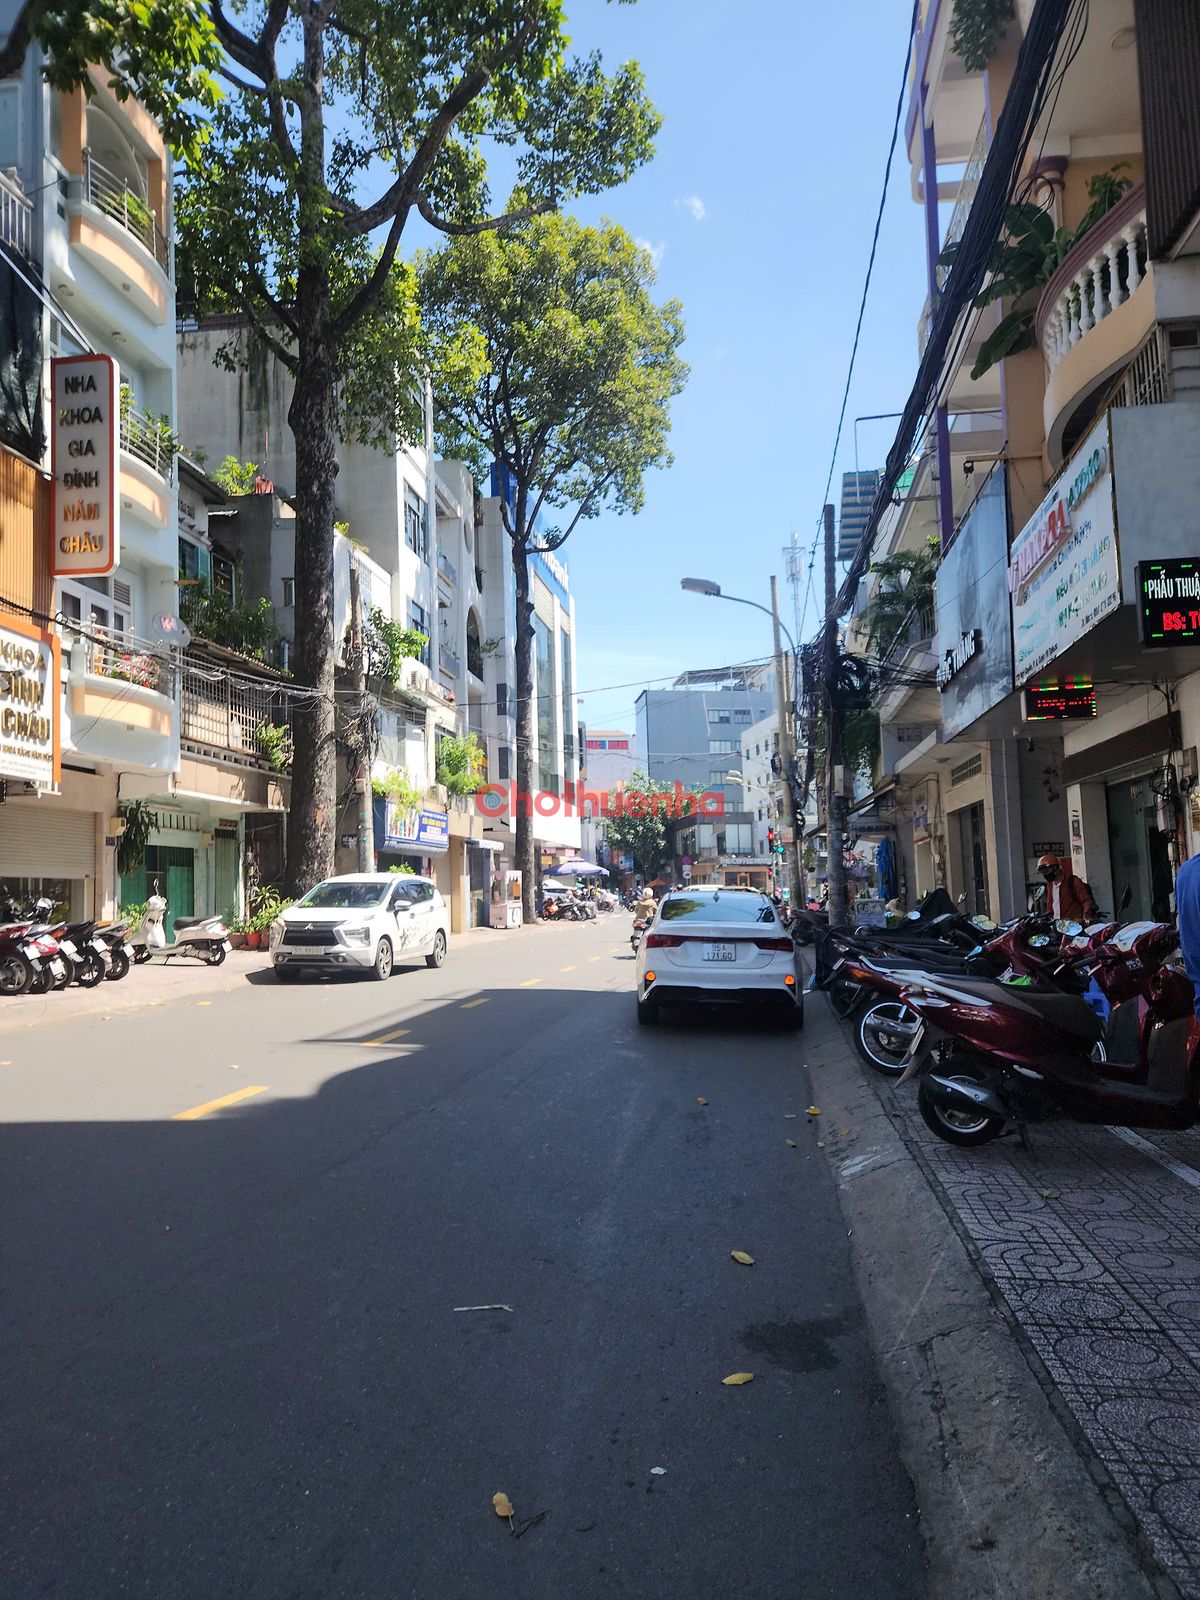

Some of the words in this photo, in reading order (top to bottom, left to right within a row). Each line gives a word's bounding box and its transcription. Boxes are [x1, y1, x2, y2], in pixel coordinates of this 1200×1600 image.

[64, 375, 97, 395] NHA
[59, 406, 104, 427] KHOA
[67, 439, 96, 459] GIA
[1147, 569, 1174, 599] PHẪU
[1163, 611, 1187, 631] BS:
